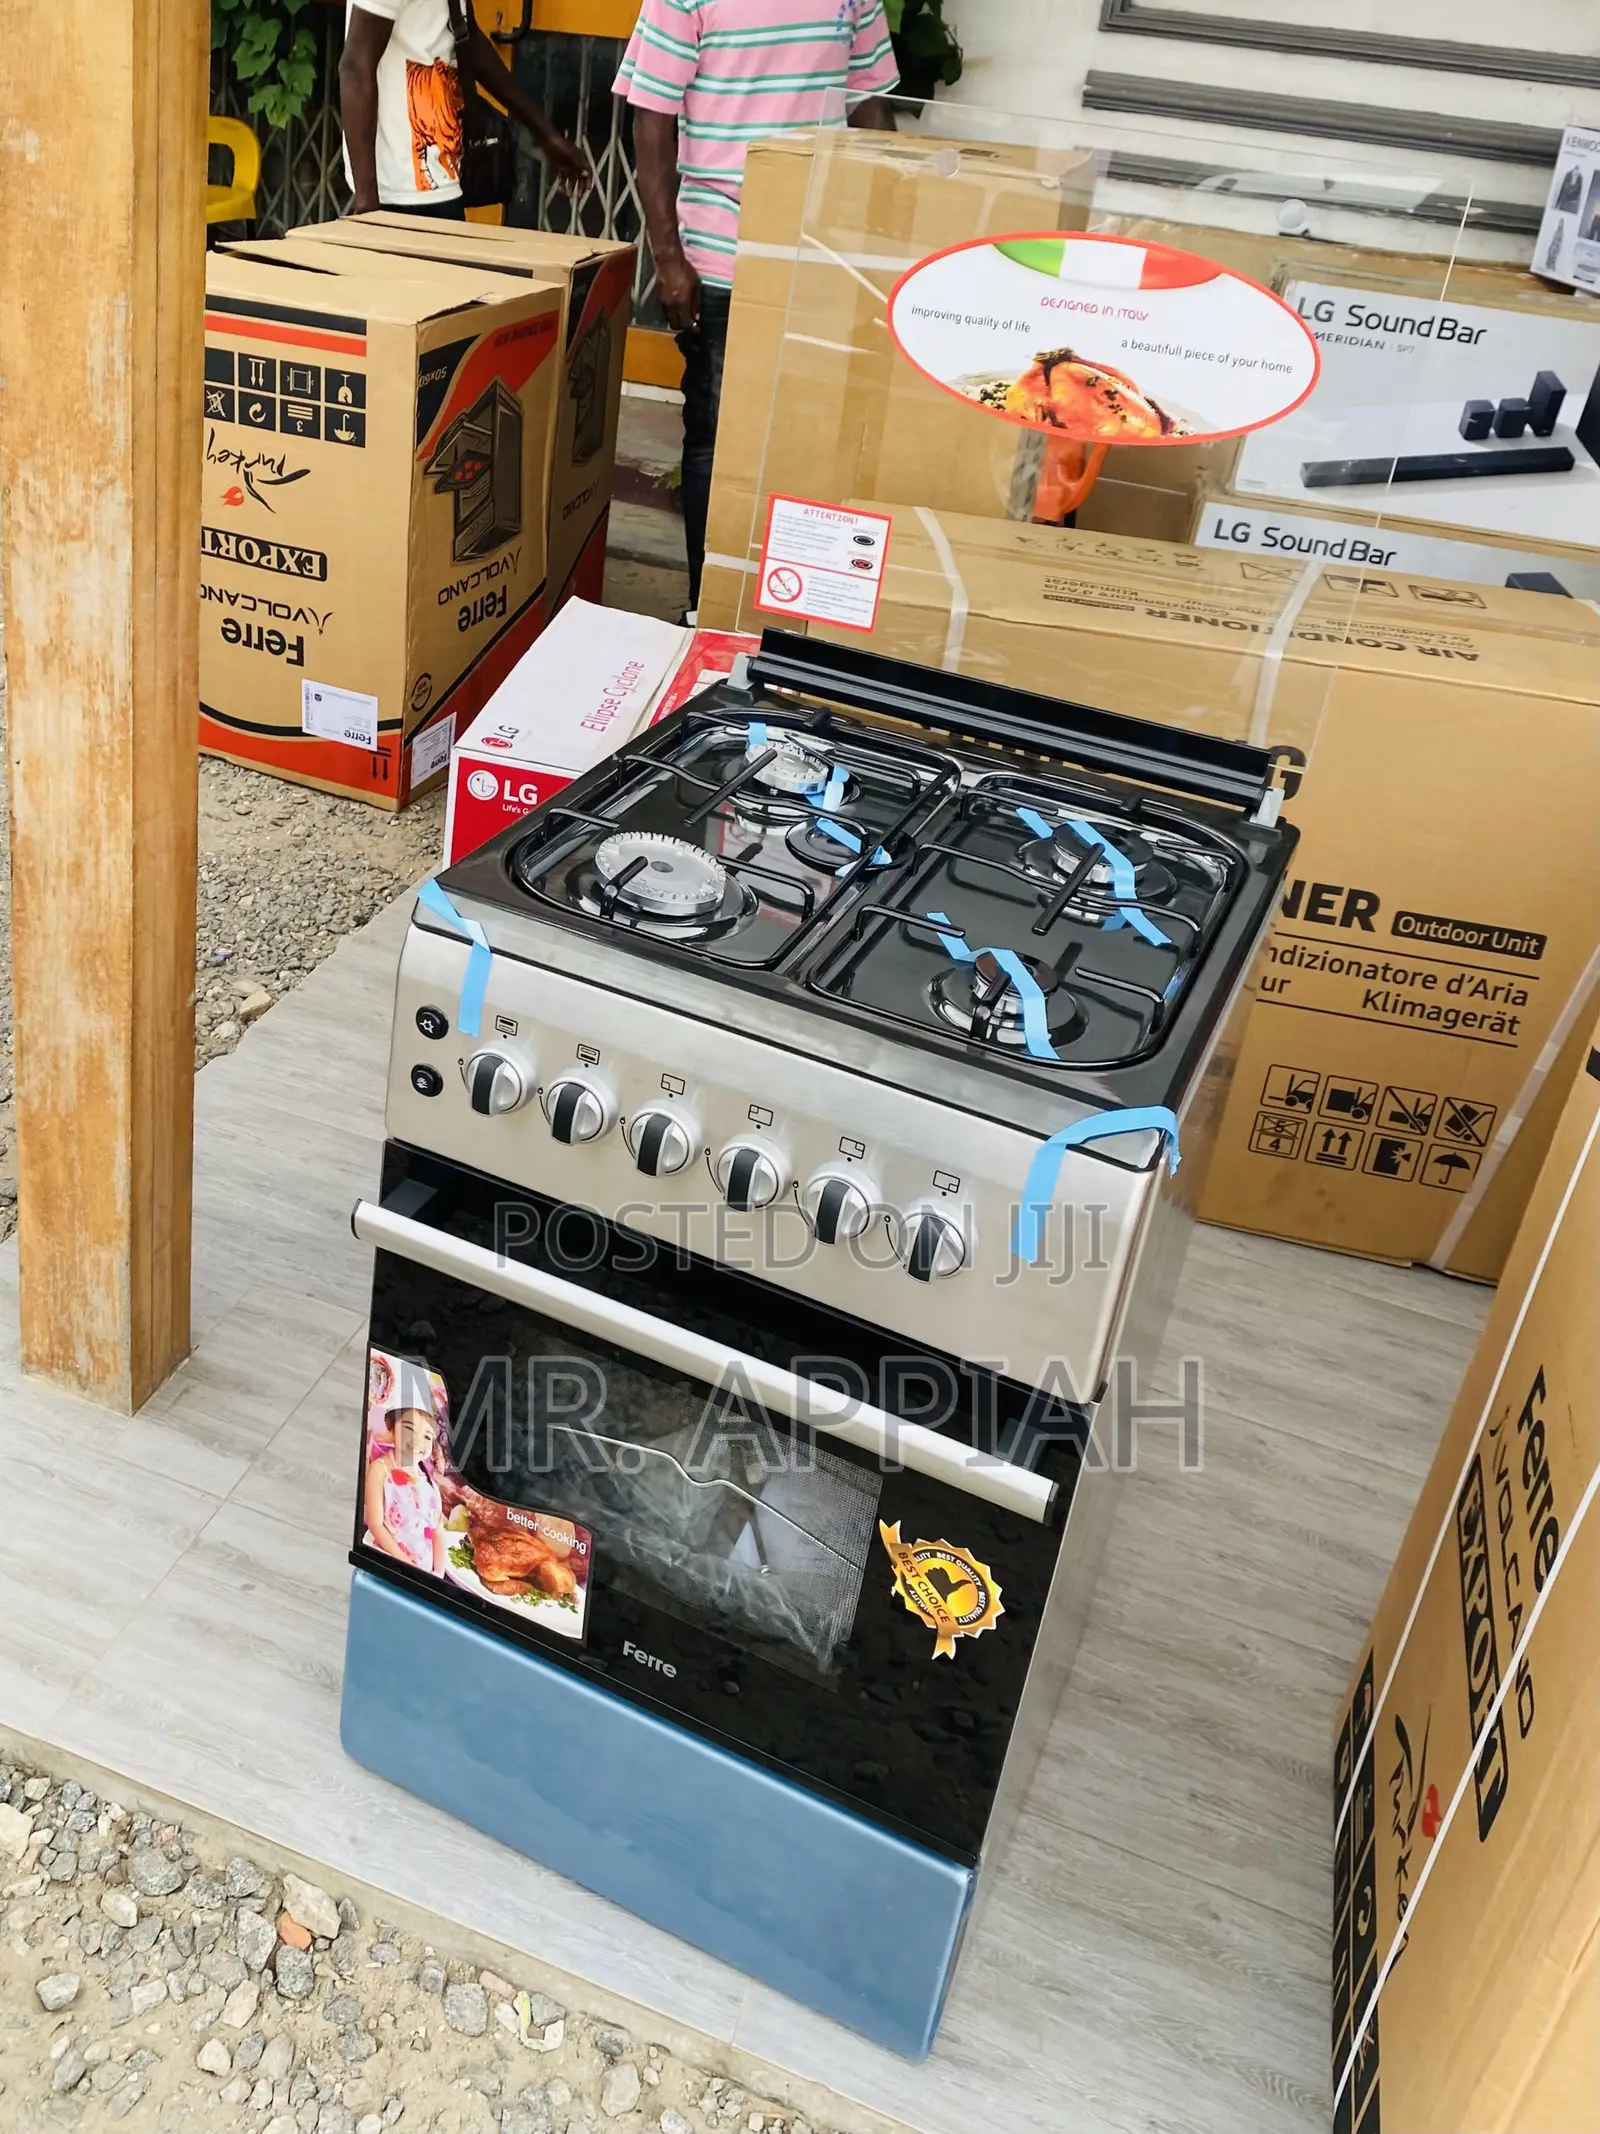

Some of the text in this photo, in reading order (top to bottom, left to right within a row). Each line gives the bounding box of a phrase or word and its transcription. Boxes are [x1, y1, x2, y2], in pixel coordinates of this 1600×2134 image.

[911, 304, 1031, 333] improving quality of life
[1040, 296, 1098, 314] DESIGNED
[1298, 297, 1336, 323] LG
[1121, 338, 1294, 374] a beautifull piece of your home
[1313, 331, 1386, 350] MERIDIAN
[803, 508, 859, 525] ATTENTION!
[1213, 518, 1252, 543] LG
[202, 528, 322, 579] EXPORT
[437, 559, 511, 606] VOLCANO
[456, 584, 508, 632] Ferre
[221, 617, 305, 667] Ferre
[1415, 645, 1480, 662] AIR
[579, 660, 645, 733] Ellipse Cyclone
[343, 729, 373, 745] Ferre
[493, 725, 520, 740] LG
[503, 780, 538, 805] LG
[1398, 915, 1490, 946] Outdoor
[1491, 931, 1541, 955] Unit
[1445, 972, 1530, 1007] d'Aria
[1361, 988, 1522, 1036] Klimagerät
[1268, 1138, 1281, 1151] 4
[1517, 1363, 1560, 1595] Ferre
[505, 1508, 588, 1556] better cooking
[936, 1552, 983, 1587] BEST QUALITY
[898, 1552, 951, 1623] BEST CHOICE
[622, 1640, 678, 1679] Ferre
